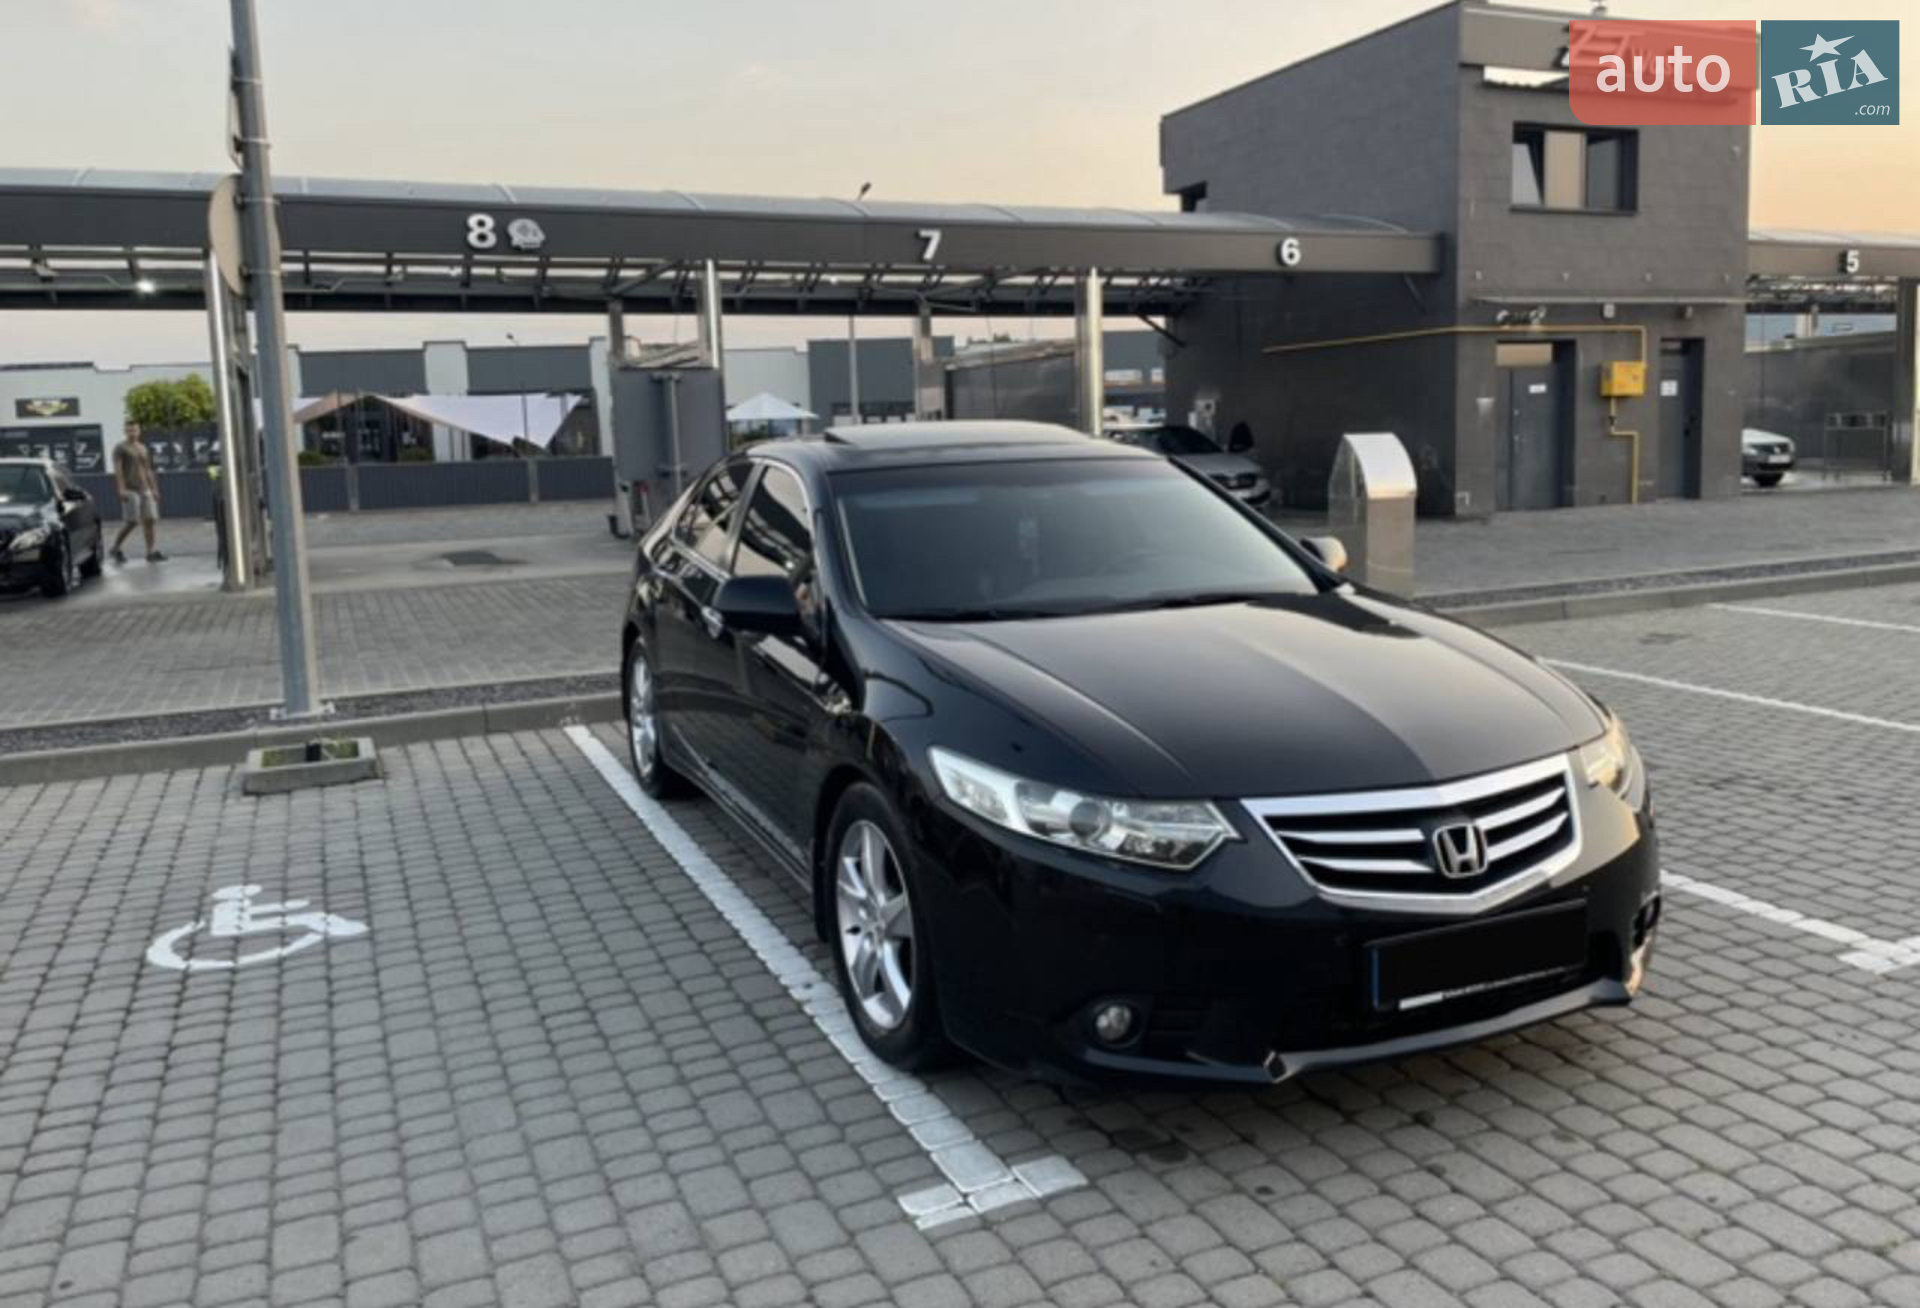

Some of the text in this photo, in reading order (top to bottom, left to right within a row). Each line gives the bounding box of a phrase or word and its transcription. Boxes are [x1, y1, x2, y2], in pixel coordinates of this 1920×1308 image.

[466, 213, 497, 248] 8
[919, 229, 942, 260] 7
[1281, 237, 1301, 266] 6
[1847, 250, 1860, 273] 5
